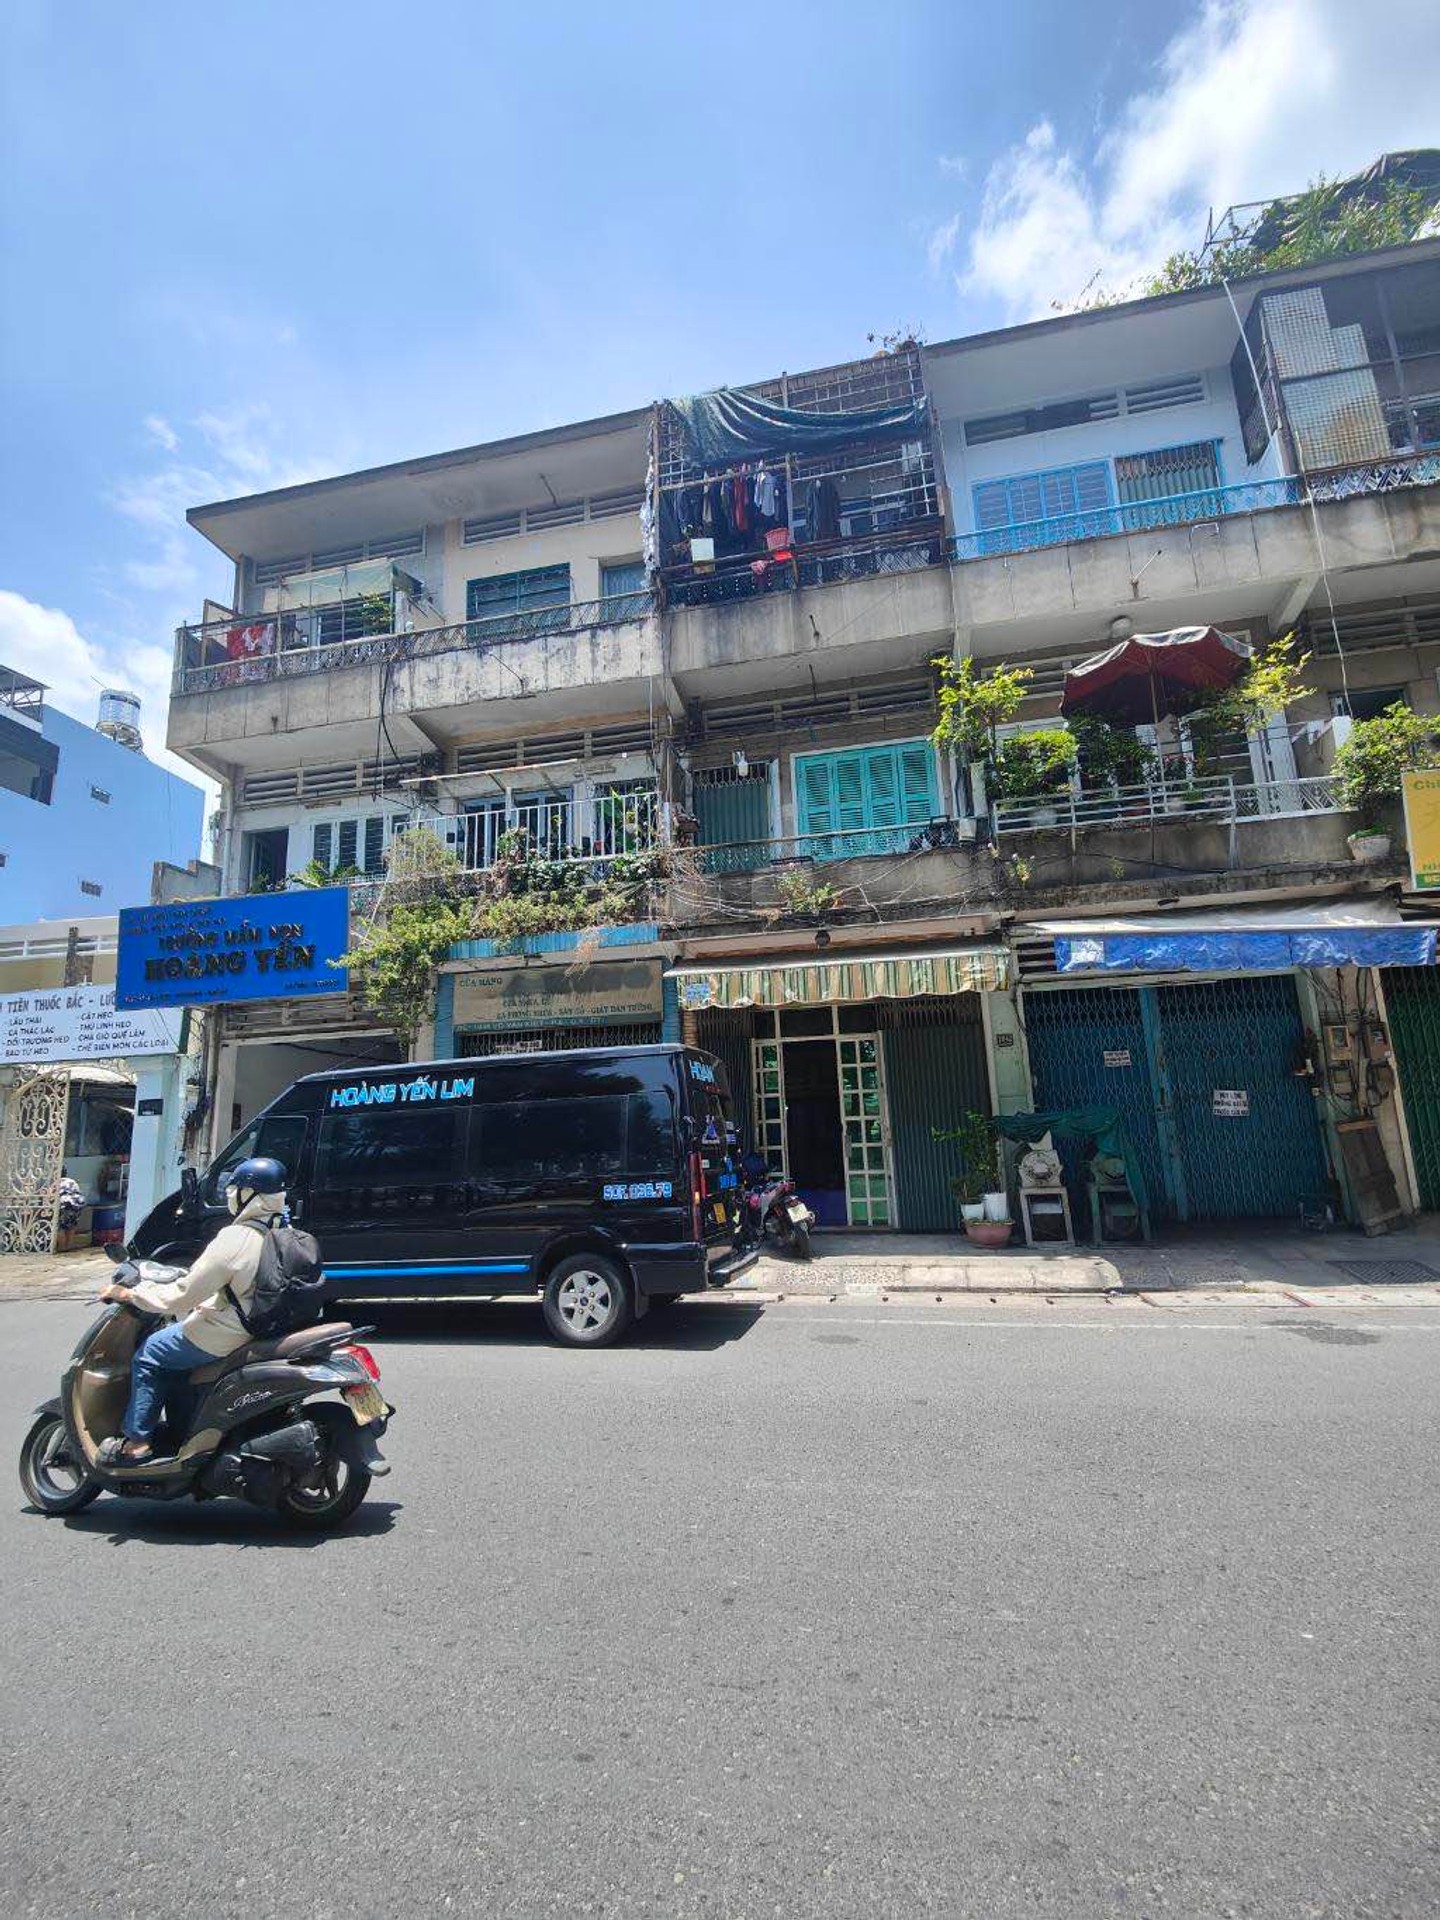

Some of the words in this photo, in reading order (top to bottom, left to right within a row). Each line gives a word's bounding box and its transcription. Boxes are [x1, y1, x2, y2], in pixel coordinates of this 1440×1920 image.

[145, 949, 247, 981] HOÀNG
[35, 994, 62, 1012] THUỐC
[66, 991, 84, 1009] BẮC
[97, 1011, 114, 1019] HEO
[115, 1020, 132, 1029] HEO
[33, 1046, 50, 1055] HEO
[331, 1081, 397, 1108] HOÀNG
[400, 1075, 438, 1101] YẾN
[441, 1077, 475, 1099] LIM
